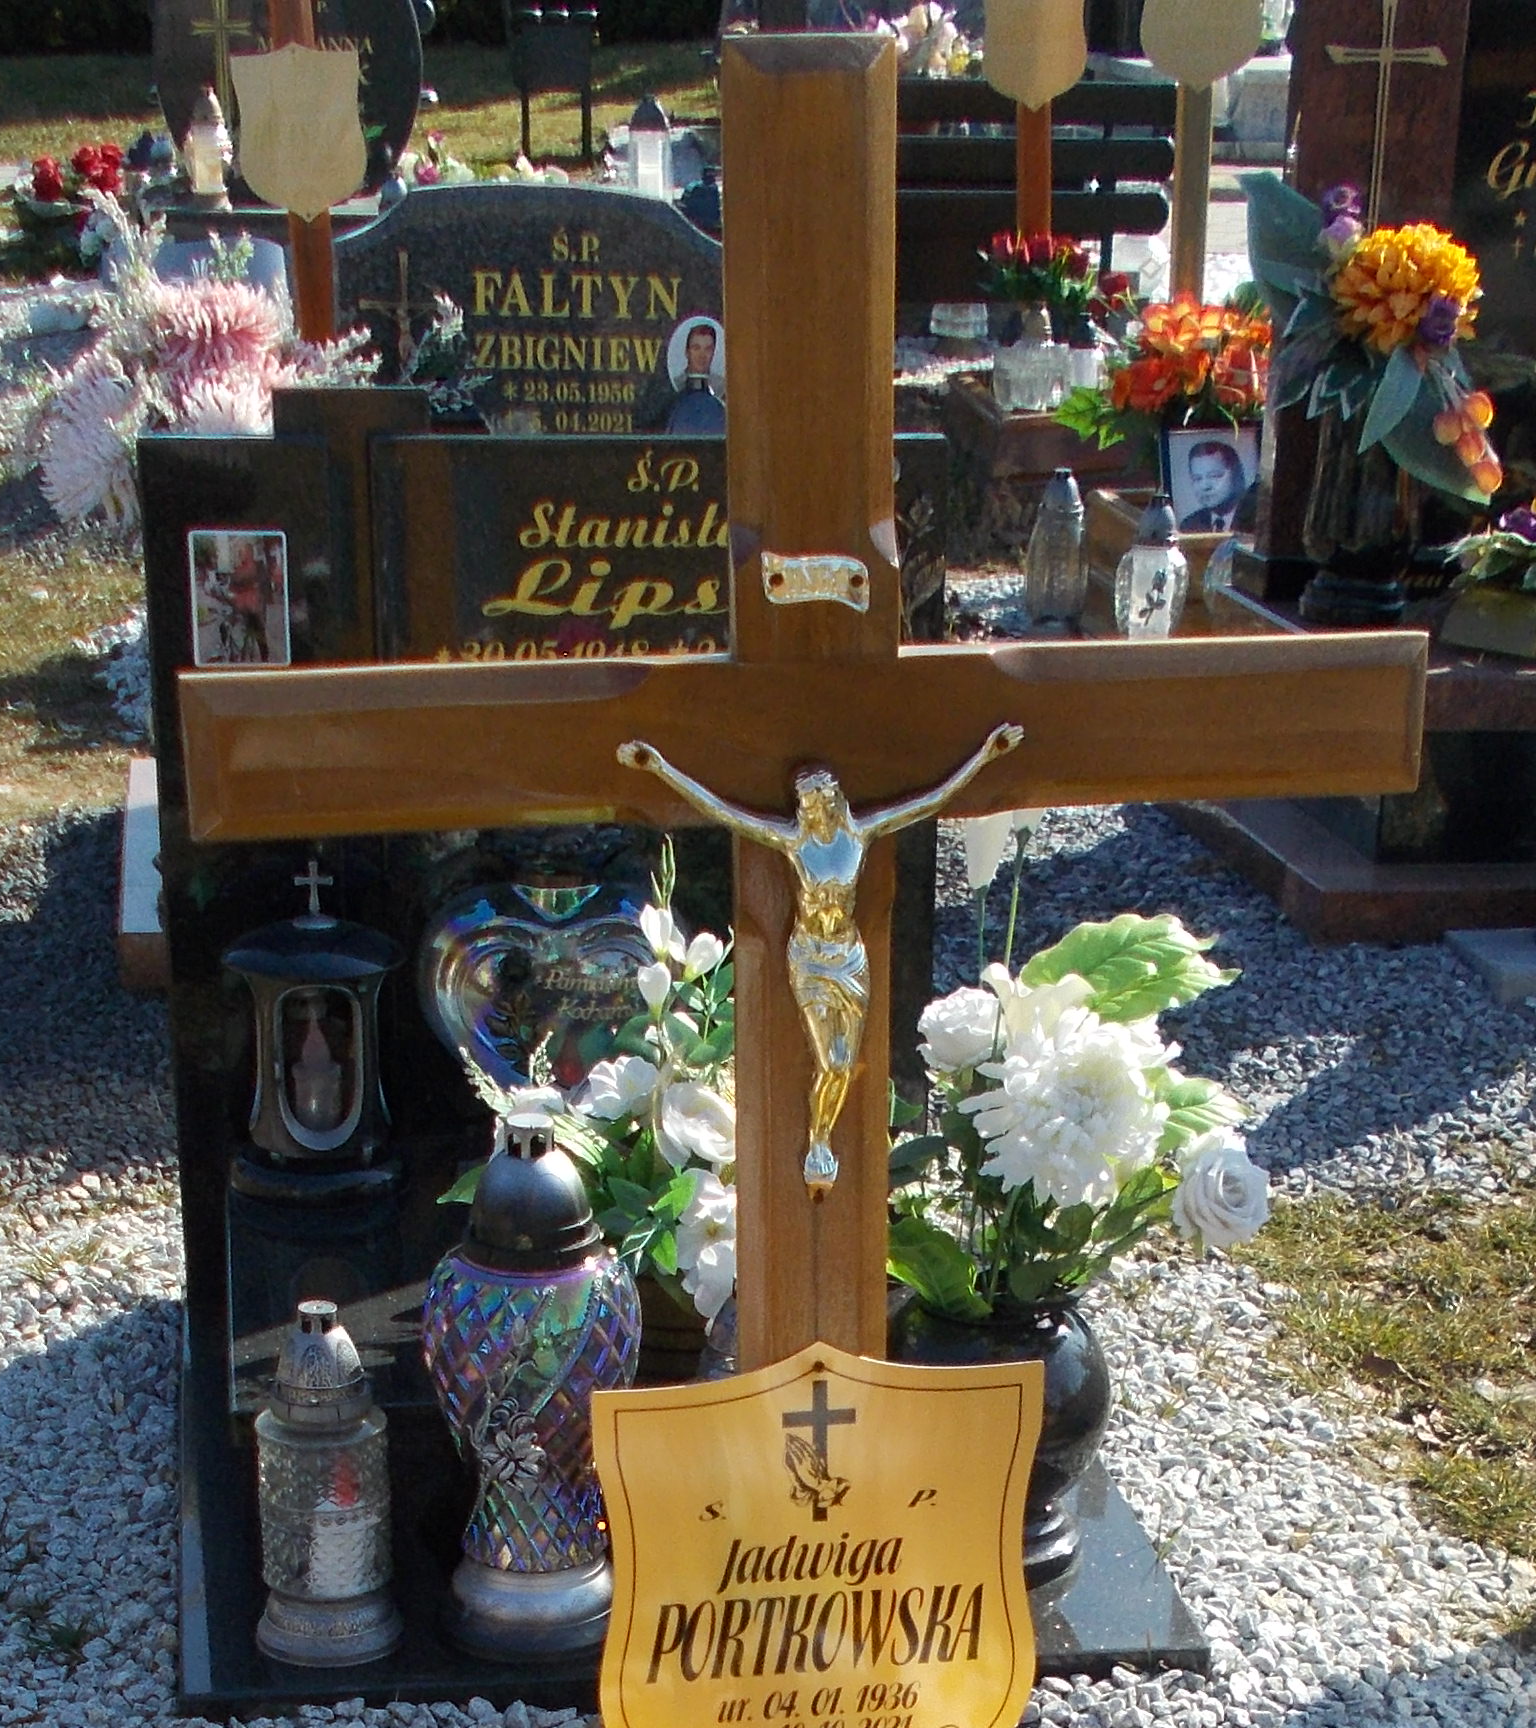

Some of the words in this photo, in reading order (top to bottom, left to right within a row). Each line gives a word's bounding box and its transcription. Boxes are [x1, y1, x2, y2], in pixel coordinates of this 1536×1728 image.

[472, 270, 683, 320] FALTYN
[474, 334, 664, 374] ZBIGNIEW
[482, 558, 729, 630] Lips
[908, 1488, 937, 1508] P.
[719, 1531, 905, 1594] Jadwiga
[646, 1583, 985, 1685] PORTKOWSKA
[717, 1696, 754, 1725] ur.
[762, 1692, 801, 1720] 04.
[810, 1690, 845, 1717] 01.
[856, 1683, 919, 1713] 1936
